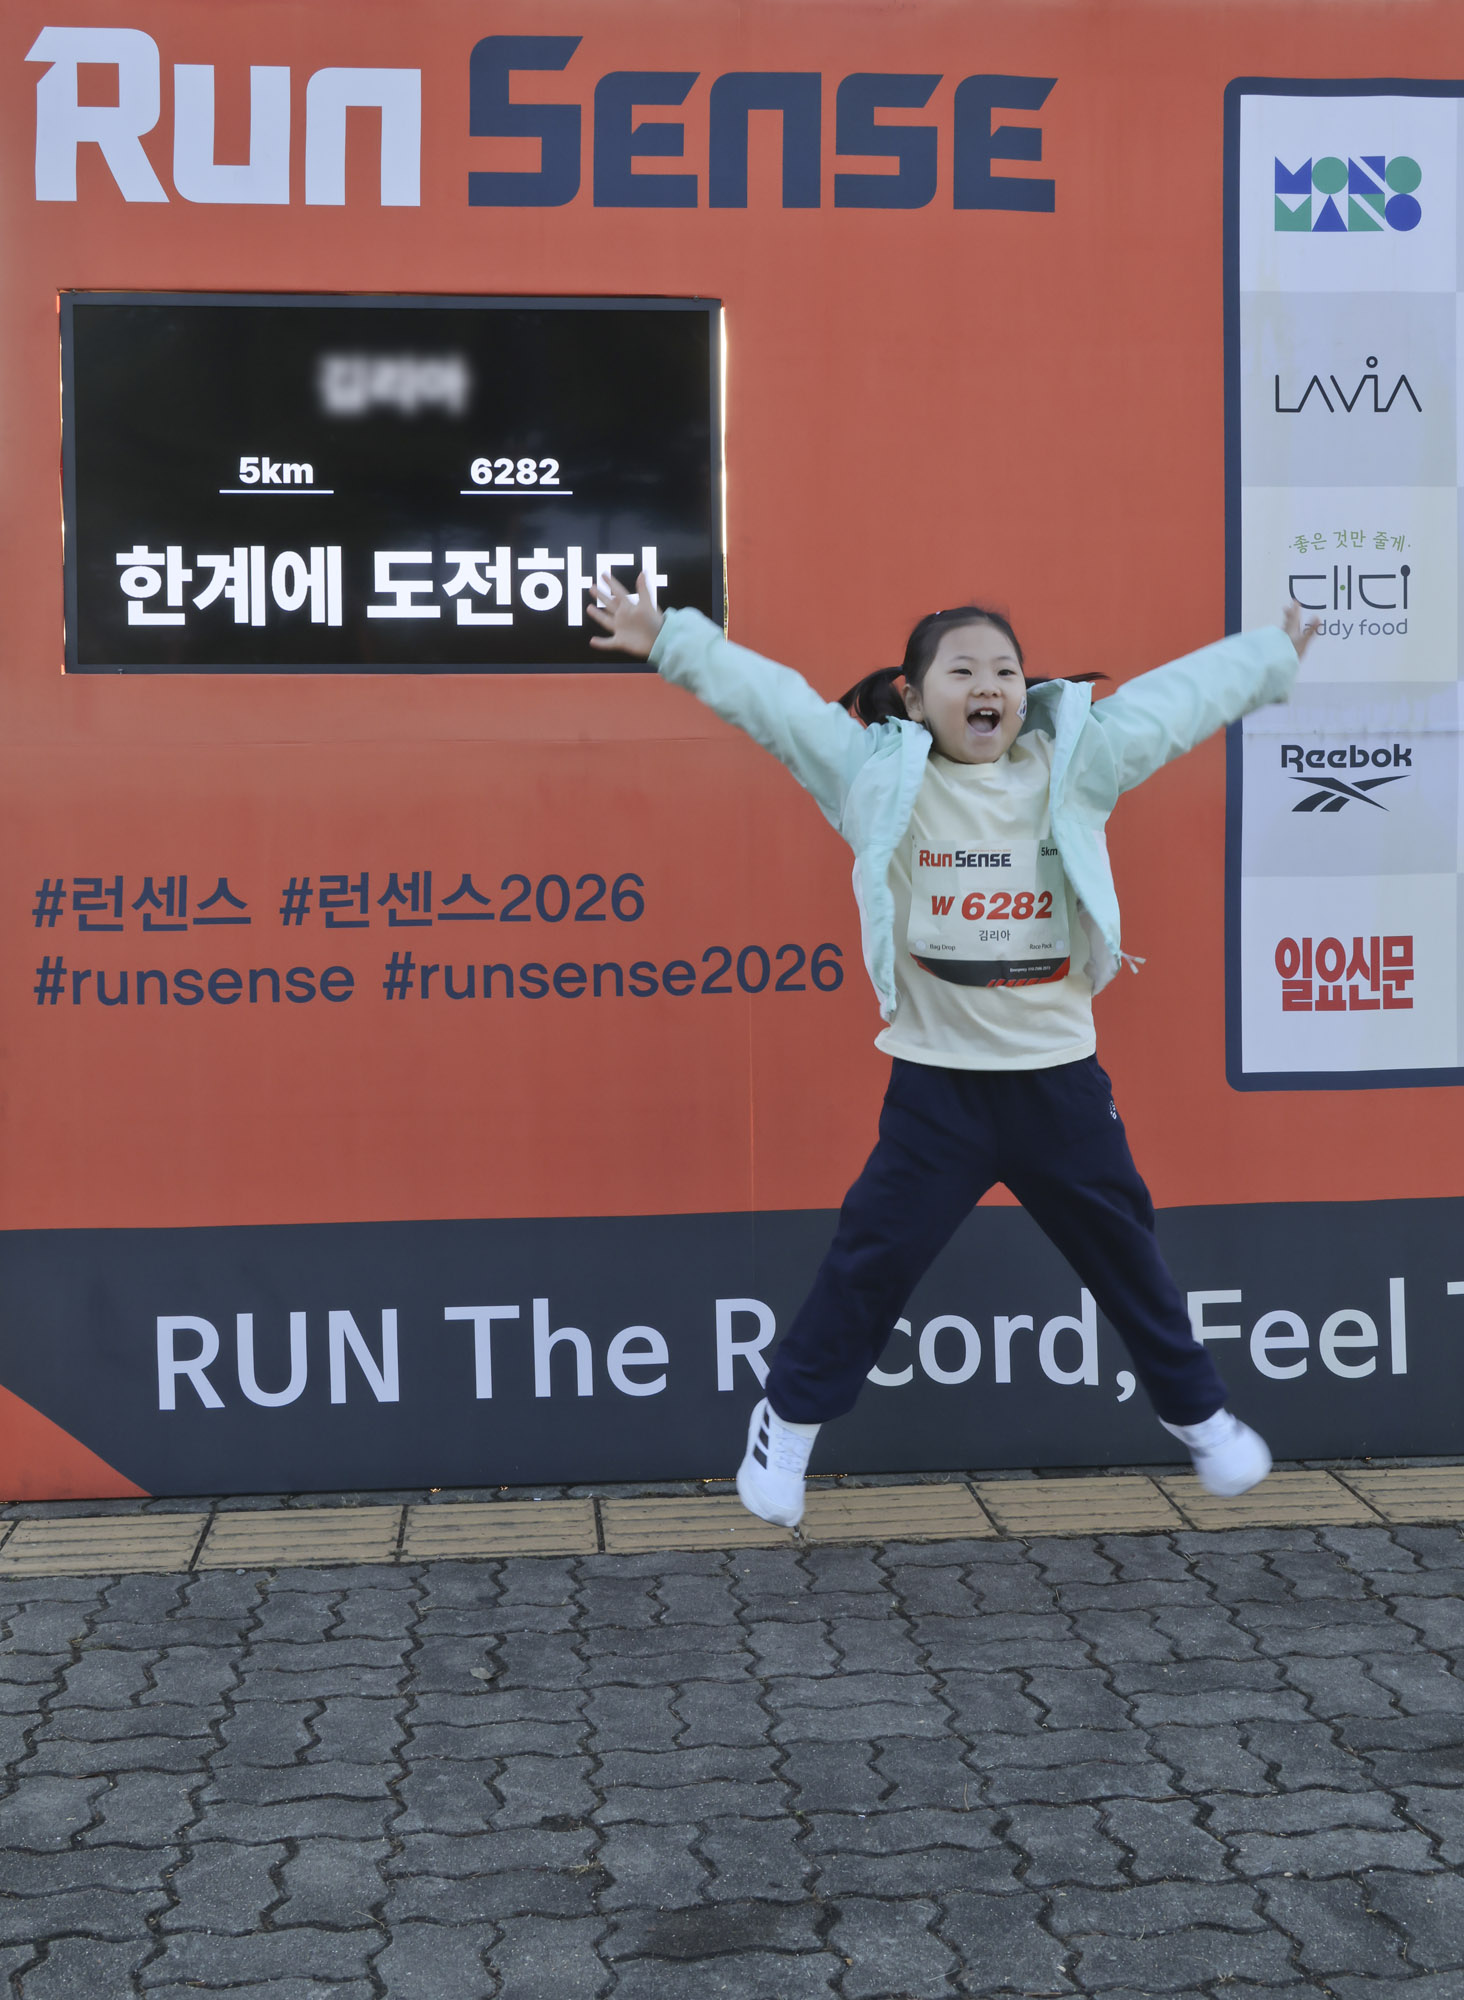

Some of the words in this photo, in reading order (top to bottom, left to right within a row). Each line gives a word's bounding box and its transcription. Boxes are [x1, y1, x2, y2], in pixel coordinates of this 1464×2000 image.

[1274, 155, 1422, 194] MONO
[1274, 194, 1422, 232] MANO
[238, 456, 314, 484] 5km
[469, 457, 560, 485] 6282
[1333, 529, 1366, 548] 것만
[115, 545, 343, 627] 한계에
[366, 545, 668, 627] 도전하다
[1358, 617, 1408, 636] food
[1281, 743, 1412, 773] Reebok
[1041, 846, 1058, 857] 5km
[32, 875, 252, 932] #런센스
[279, 870, 646, 930] #런센스2026
[961, 890, 1053, 921] 6282
[978, 929, 1011, 942] 김리아
[33, 955, 355, 1006] #runsense
[382, 942, 844, 1001] #runsense2026
[1275, 935, 1414, 1012] 일요신문
[156, 1308, 400, 1411] RUN
[444, 1297, 669, 1399] The
[715, 1287, 1137, 1403] Rcord,
[1186, 1276, 1408, 1380] Feel
